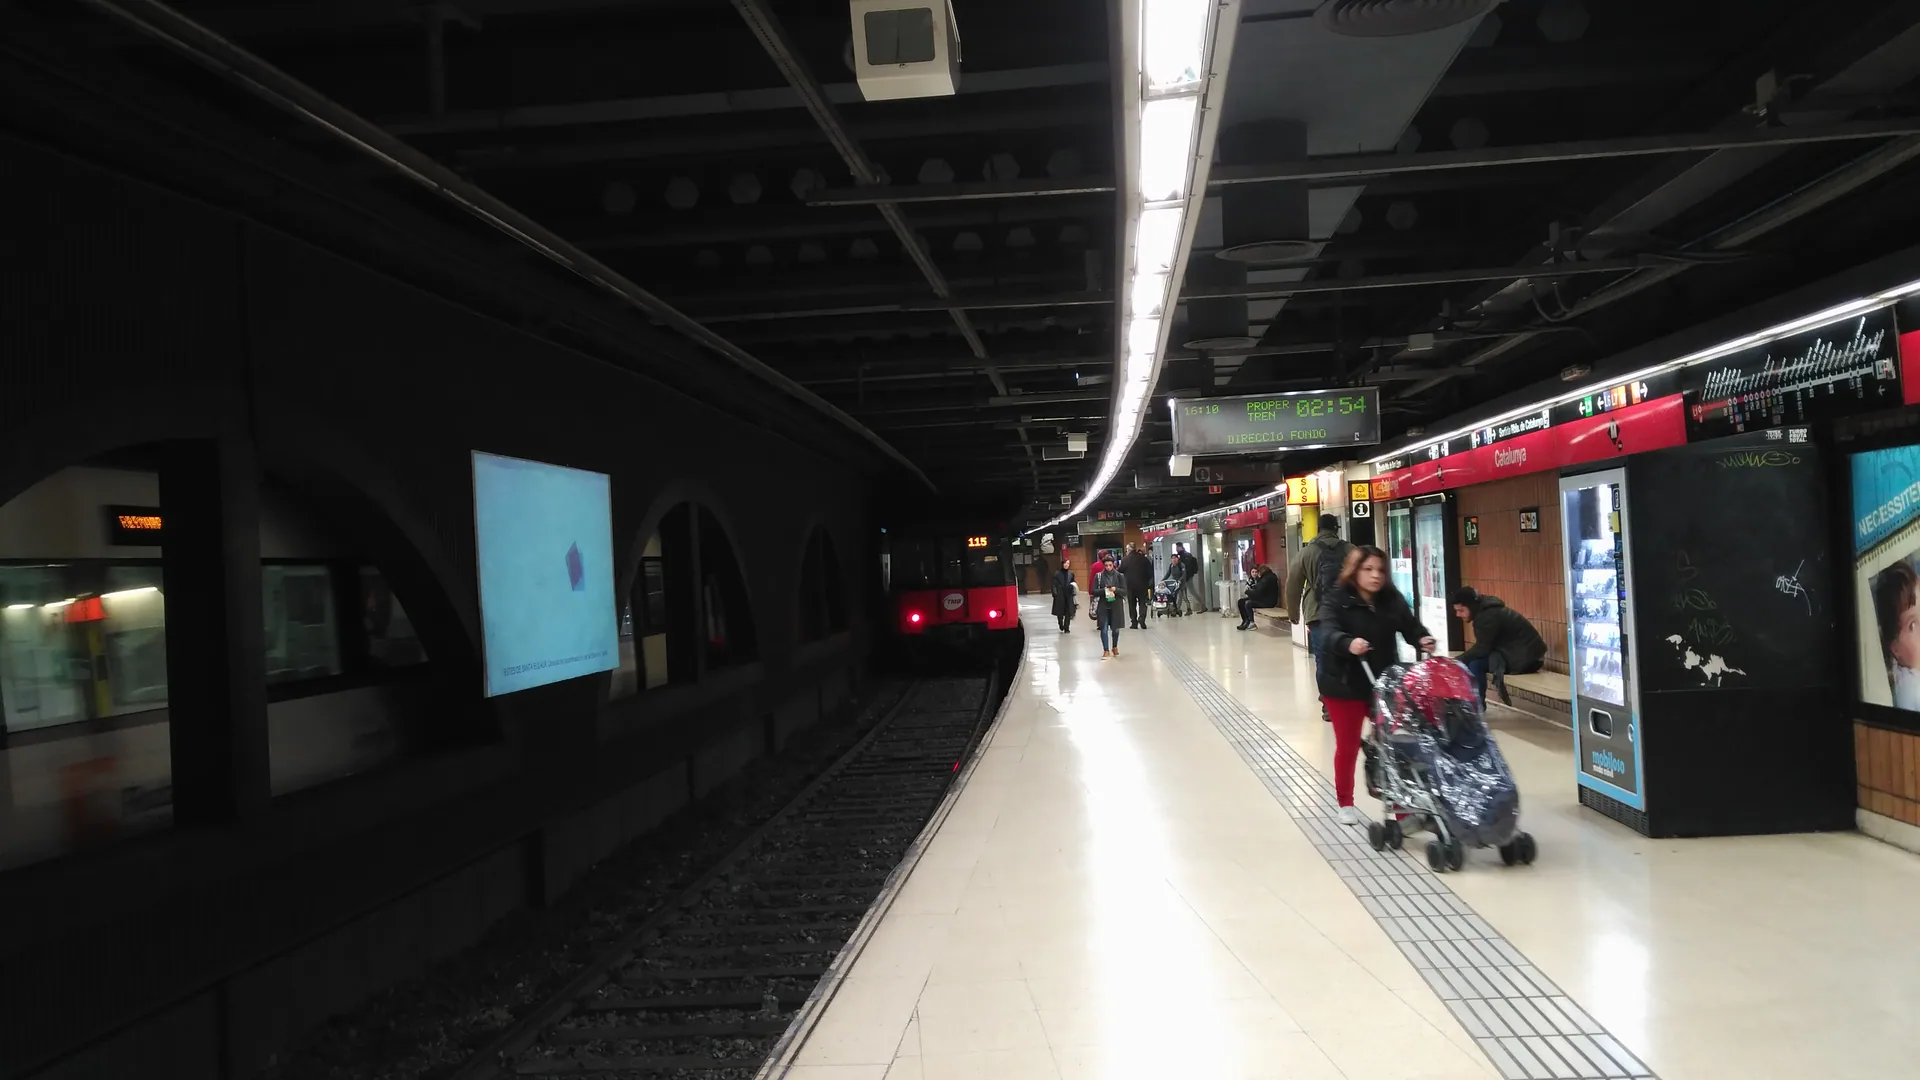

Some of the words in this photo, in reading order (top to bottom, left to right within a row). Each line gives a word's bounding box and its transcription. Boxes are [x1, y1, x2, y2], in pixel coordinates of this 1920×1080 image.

[1184, 404, 1219, 416] 16:10
[1246, 400, 1289, 411] PROPER
[1296, 396, 1366, 417] 02:54
[1248, 411, 1276, 421] TREN
[1290, 428, 1327, 440] FONDO
[1494, 446, 1527, 467] Catalunya
[1300, 479, 1308, 503] SOS
[968, 537, 988, 547] 115
